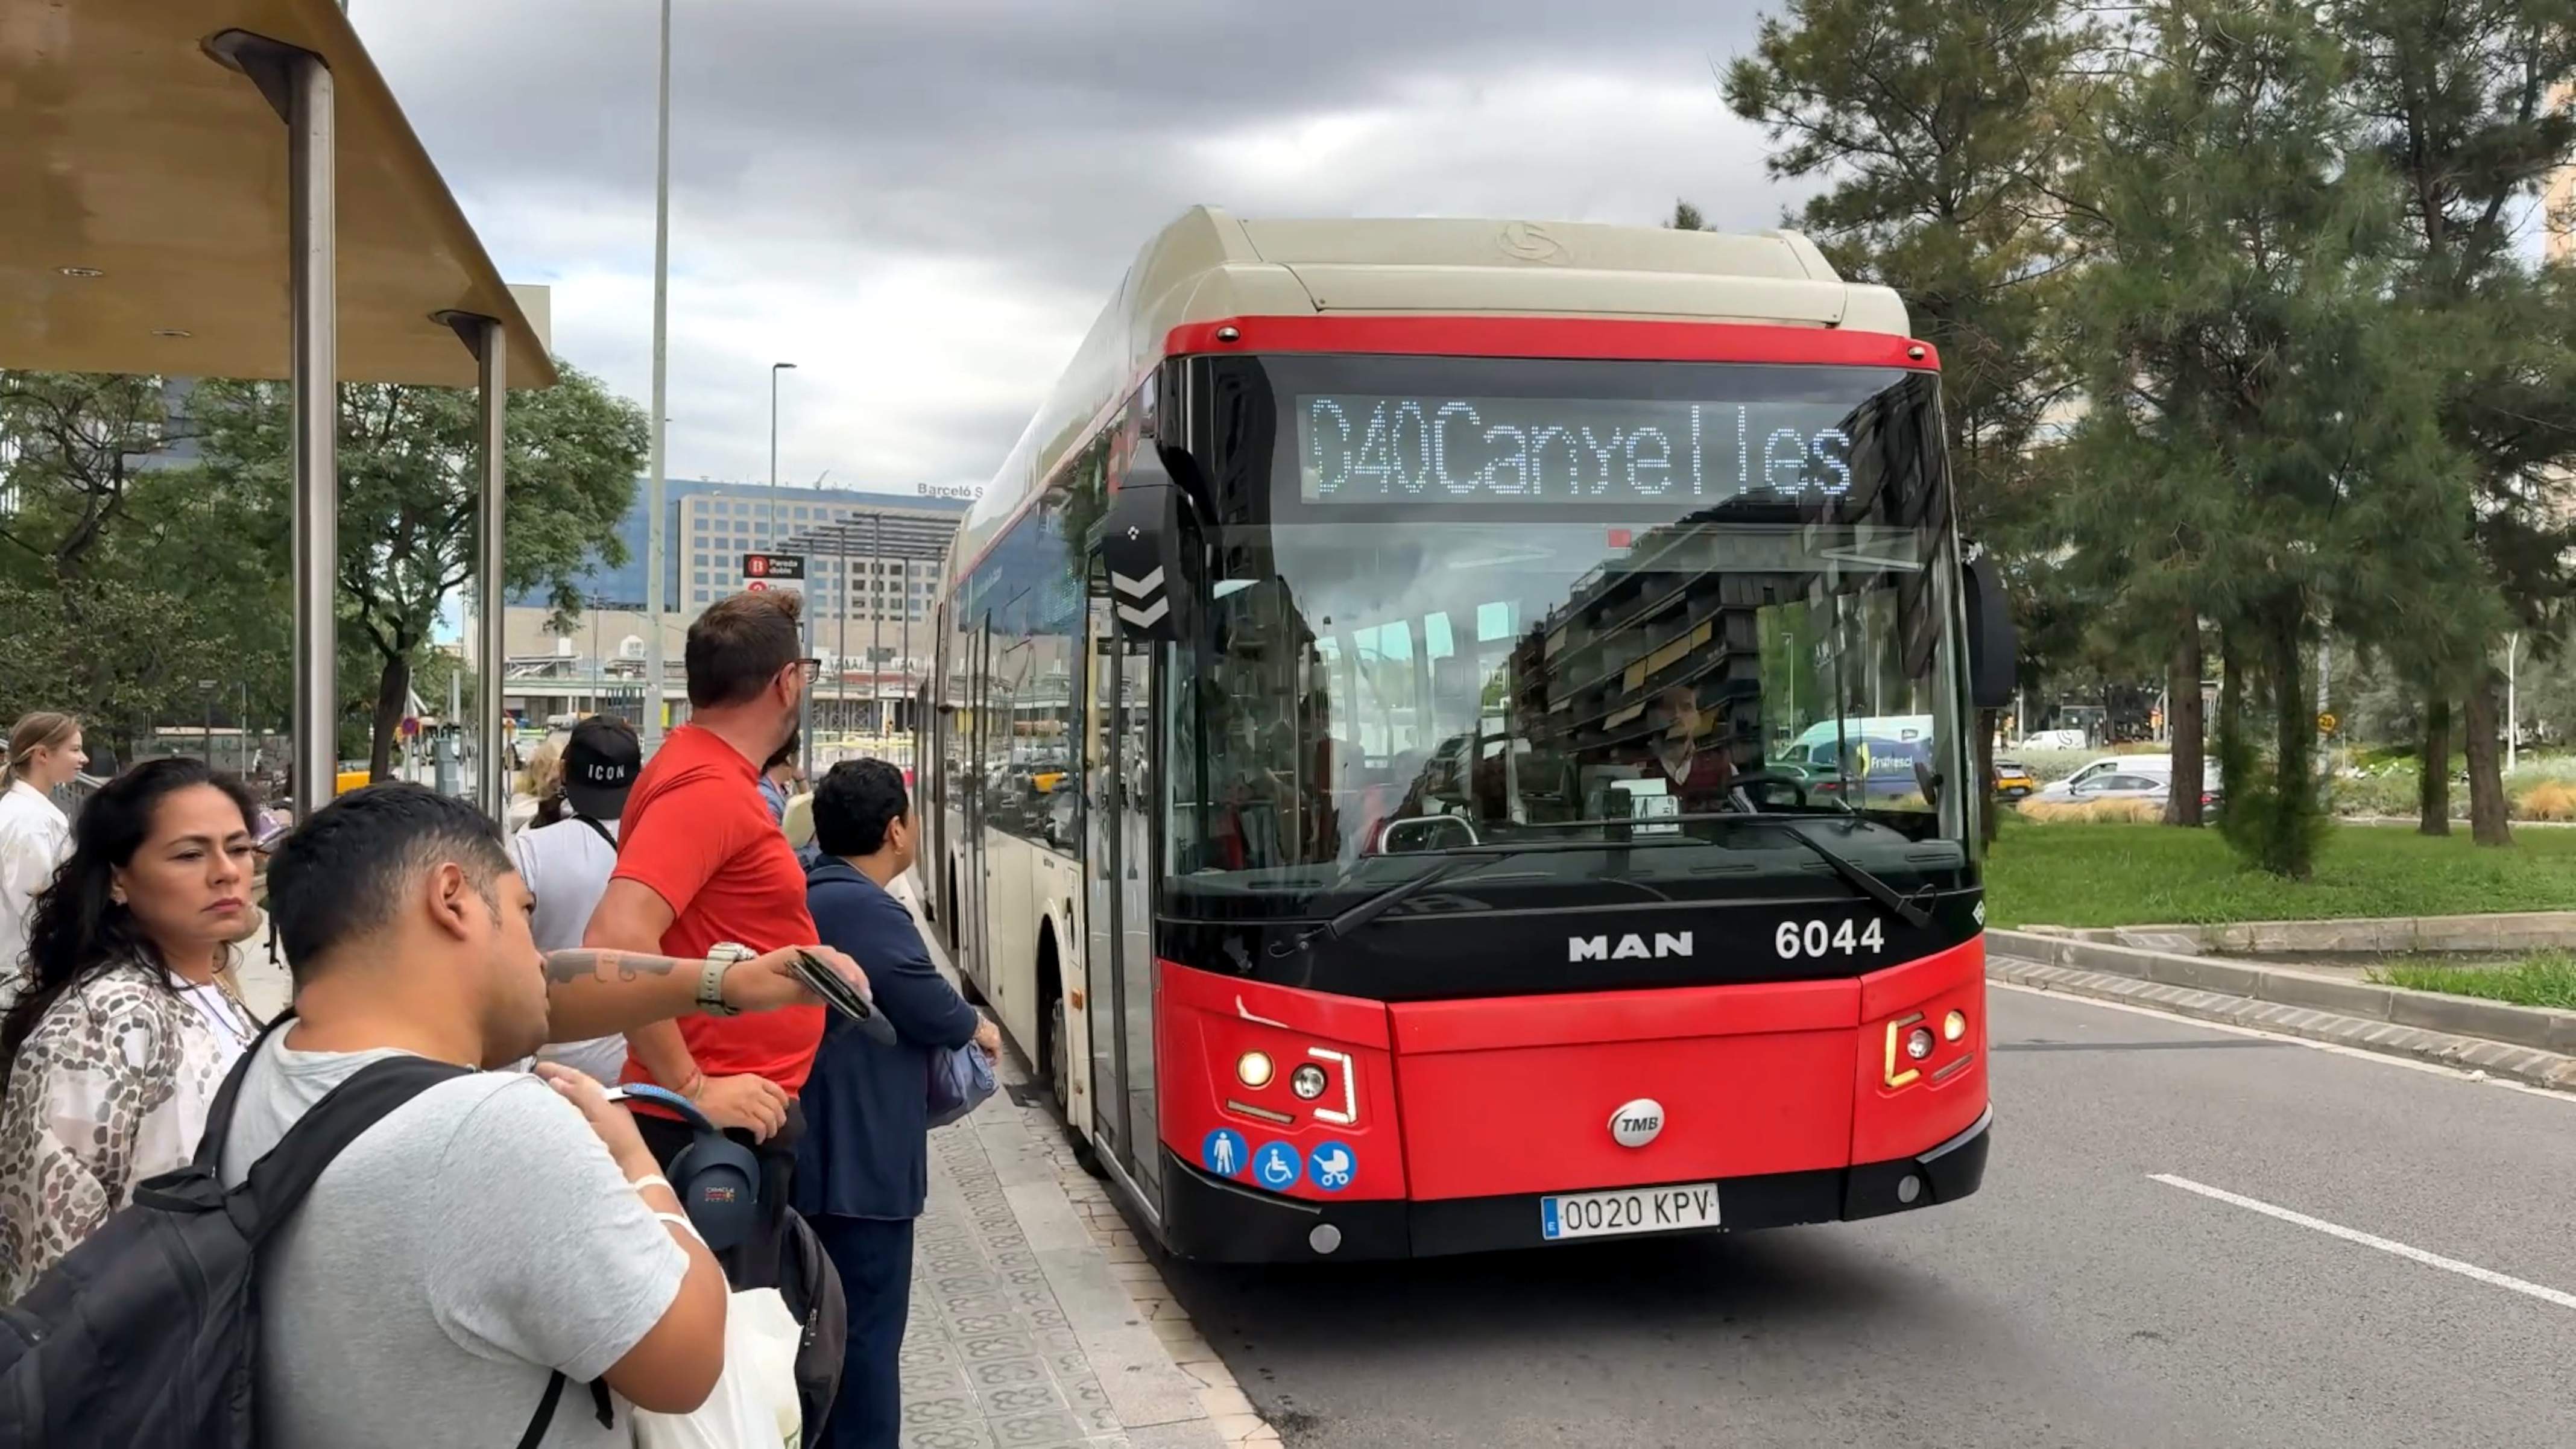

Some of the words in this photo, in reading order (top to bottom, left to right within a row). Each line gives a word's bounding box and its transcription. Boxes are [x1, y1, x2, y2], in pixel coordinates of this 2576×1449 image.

[918, 483, 971, 497] Barceló
[753, 560, 763, 572] B
[588, 763, 625, 780] ICON
[1568, 931, 1693, 962] MAN
[1775, 917, 1885, 959] 6044
[1622, 1117, 1658, 1131] TMB
[1566, 1196, 1642, 1230] 0020
[1655, 1190, 1709, 1223] KPV
